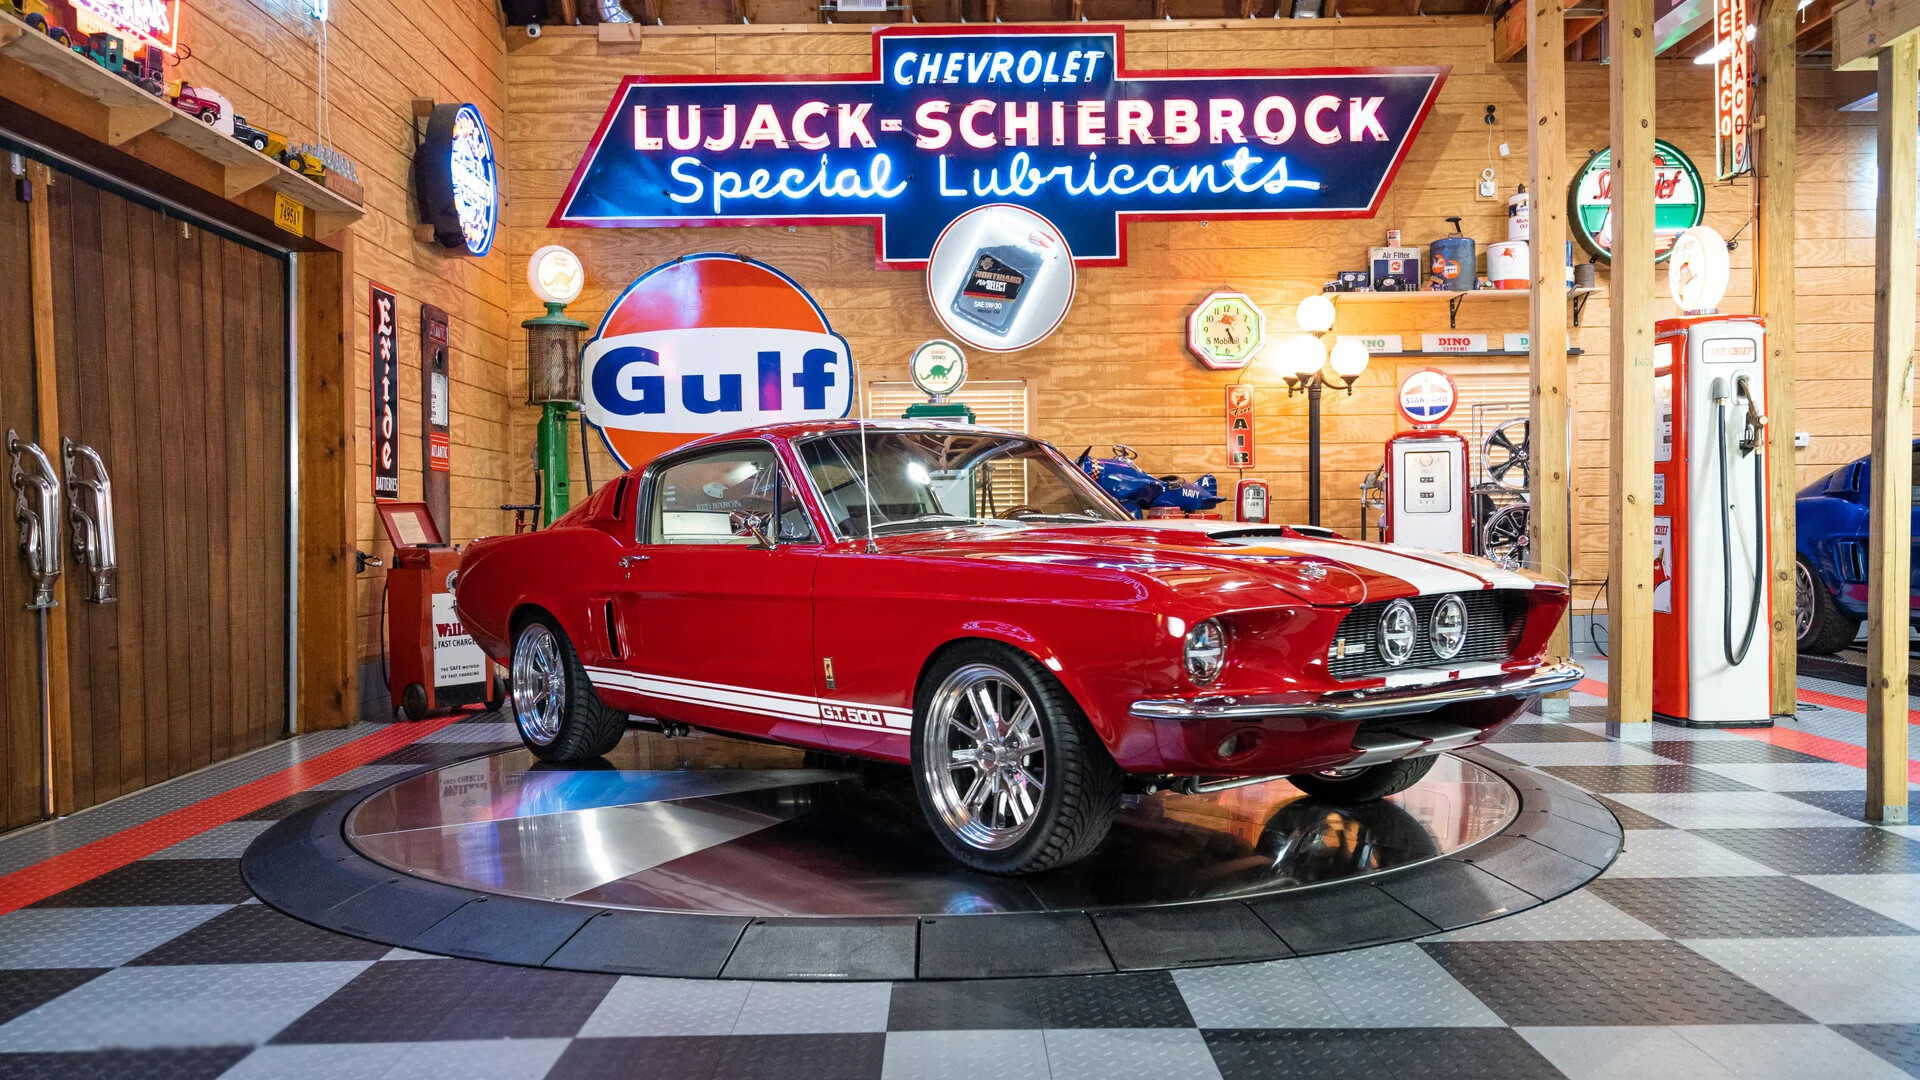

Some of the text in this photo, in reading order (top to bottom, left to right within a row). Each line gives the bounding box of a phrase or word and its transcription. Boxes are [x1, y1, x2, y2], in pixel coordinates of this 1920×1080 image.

[893, 50, 1105, 86] CHEVROLET
[1720, 0, 1732, 138] EACO
[669, 146, 1321, 214] Special Lubricants
[1382, 251, 1410, 259] Air Filter
[1432, 258, 1443, 269] AC
[973, 300, 985, 309] SAE
[1223, 304, 1231, 313] 12
[1206, 315, 1214, 323] 10
[1438, 337, 1471, 346] DINO
[1728, 346, 1754, 356] CHIEF
[377, 297, 393, 471] Exide
[591, 346, 838, 416] Gulf
[1405, 396, 1448, 404] STANARD
[1230, 407, 1251, 416] Free
[1232, 418, 1250, 463] AIR
[431, 444, 449, 459] ATLANTIC
[375, 476, 398, 492] BATTERIES
[1202, 477, 1210, 487] A
[1182, 488, 1200, 499] NAVY
[711, 500, 742, 510] BARON
[438, 640, 451, 649] FAST
